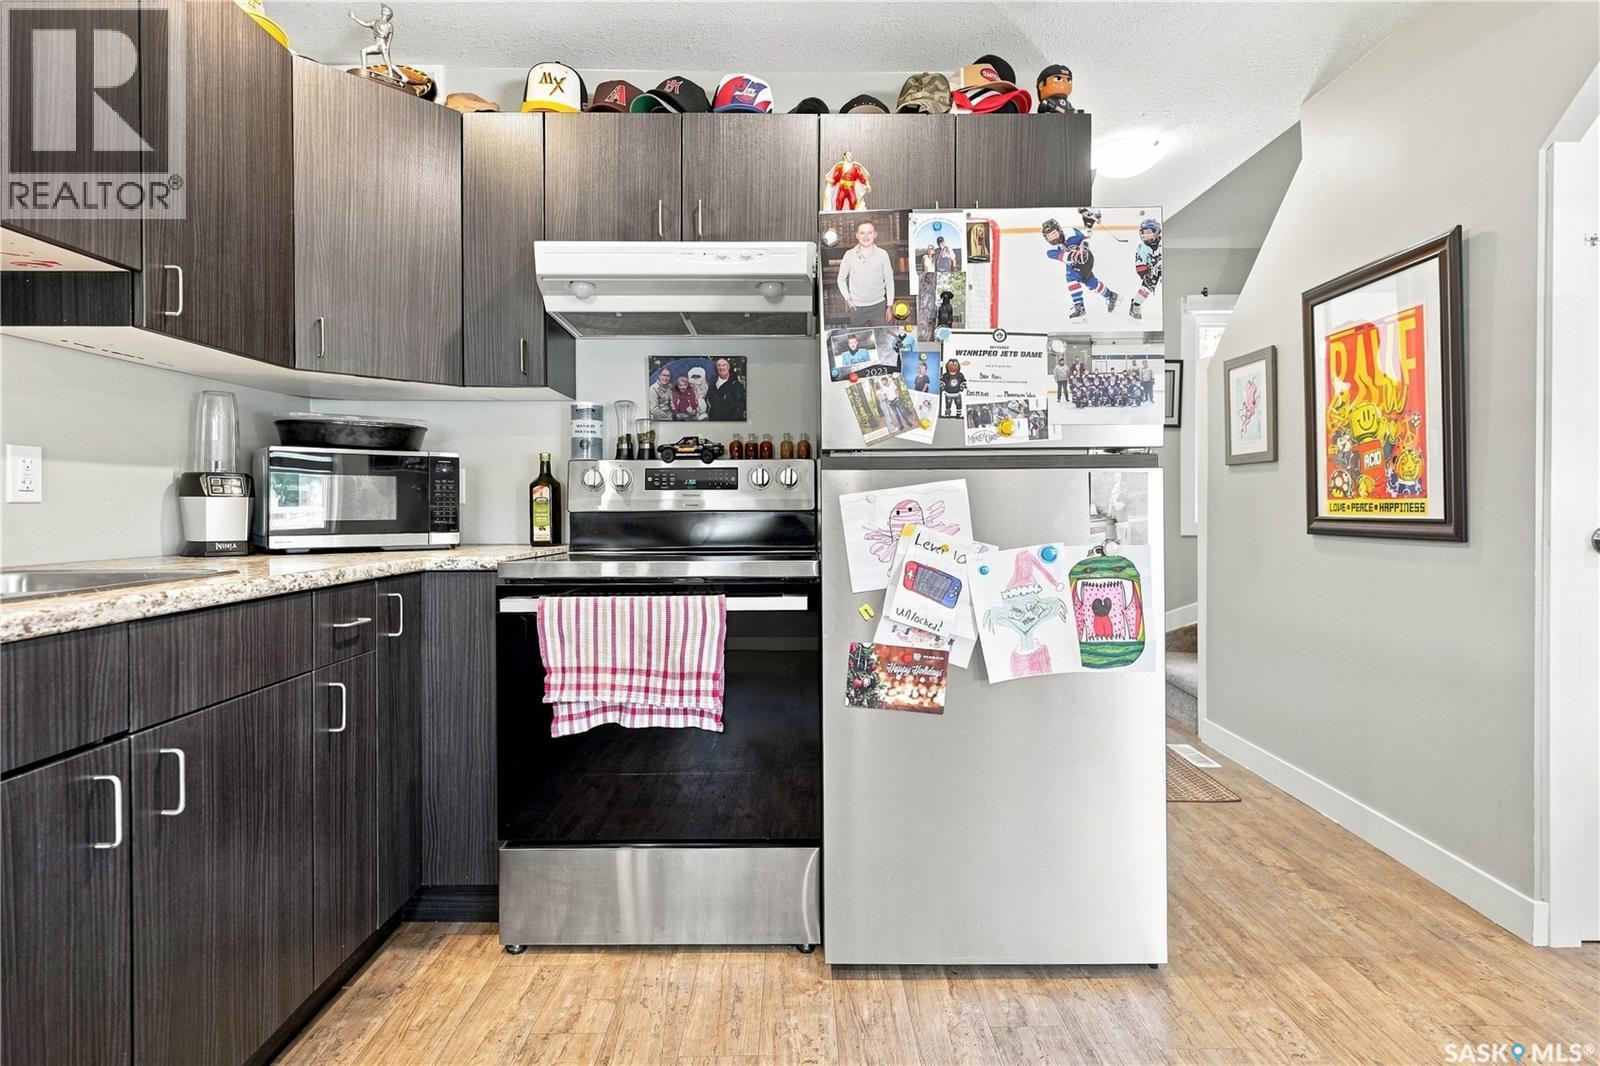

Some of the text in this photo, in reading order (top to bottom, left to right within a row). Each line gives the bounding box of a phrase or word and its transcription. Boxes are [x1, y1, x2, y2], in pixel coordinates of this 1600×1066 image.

[999, 350, 1019, 358] JETS
[865, 367, 888, 378] 2023
[1364, 450, 1382, 469] ACID
[1329, 502, 1426, 513] LOVE PEACE HAPPINESS
[215, 542, 238, 551] NINJA
[886, 662, 944, 679] Happy Holidays
